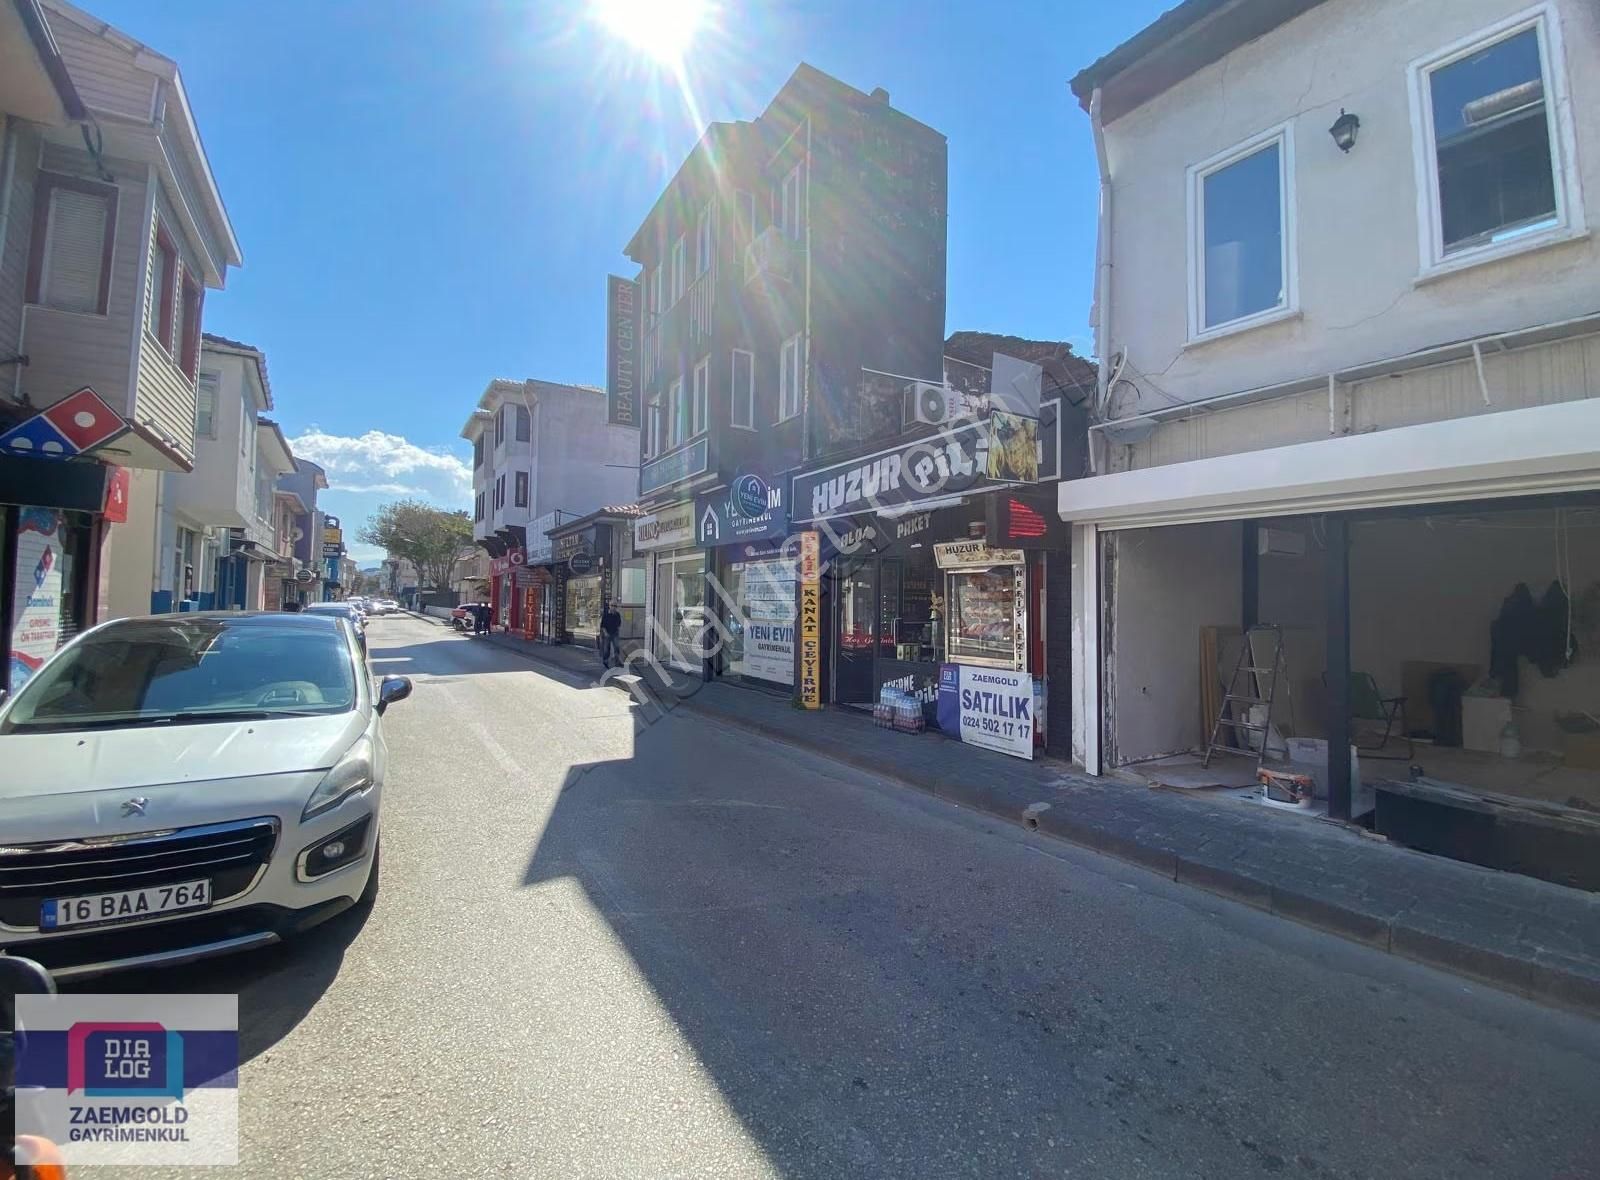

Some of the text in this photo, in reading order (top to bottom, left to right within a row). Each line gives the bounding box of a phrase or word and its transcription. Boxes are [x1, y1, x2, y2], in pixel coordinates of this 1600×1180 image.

[617, 283, 633, 423] BEAUTY CENTER
[812, 454, 901, 516] HUZUR
[896, 511, 931, 539] PAKET
[945, 544, 980, 555] HUZUR
[803, 588, 817, 633] KANAT
[750, 622, 770, 640] YENİ
[803, 640, 817, 703] ÇEVİRME
[971, 673, 1019, 687] ZAEMGOLD
[962, 688, 1030, 721] SATILIK
[962, 715, 980, 729] 0224
[982, 717, 1000, 734] 502
[1002, 721, 1014, 737] 17
[1017, 724, 1031, 739] 17
[62, 899, 91, 923] 16
[100, 891, 149, 917] BAA
[159, 882, 206, 909] 764
